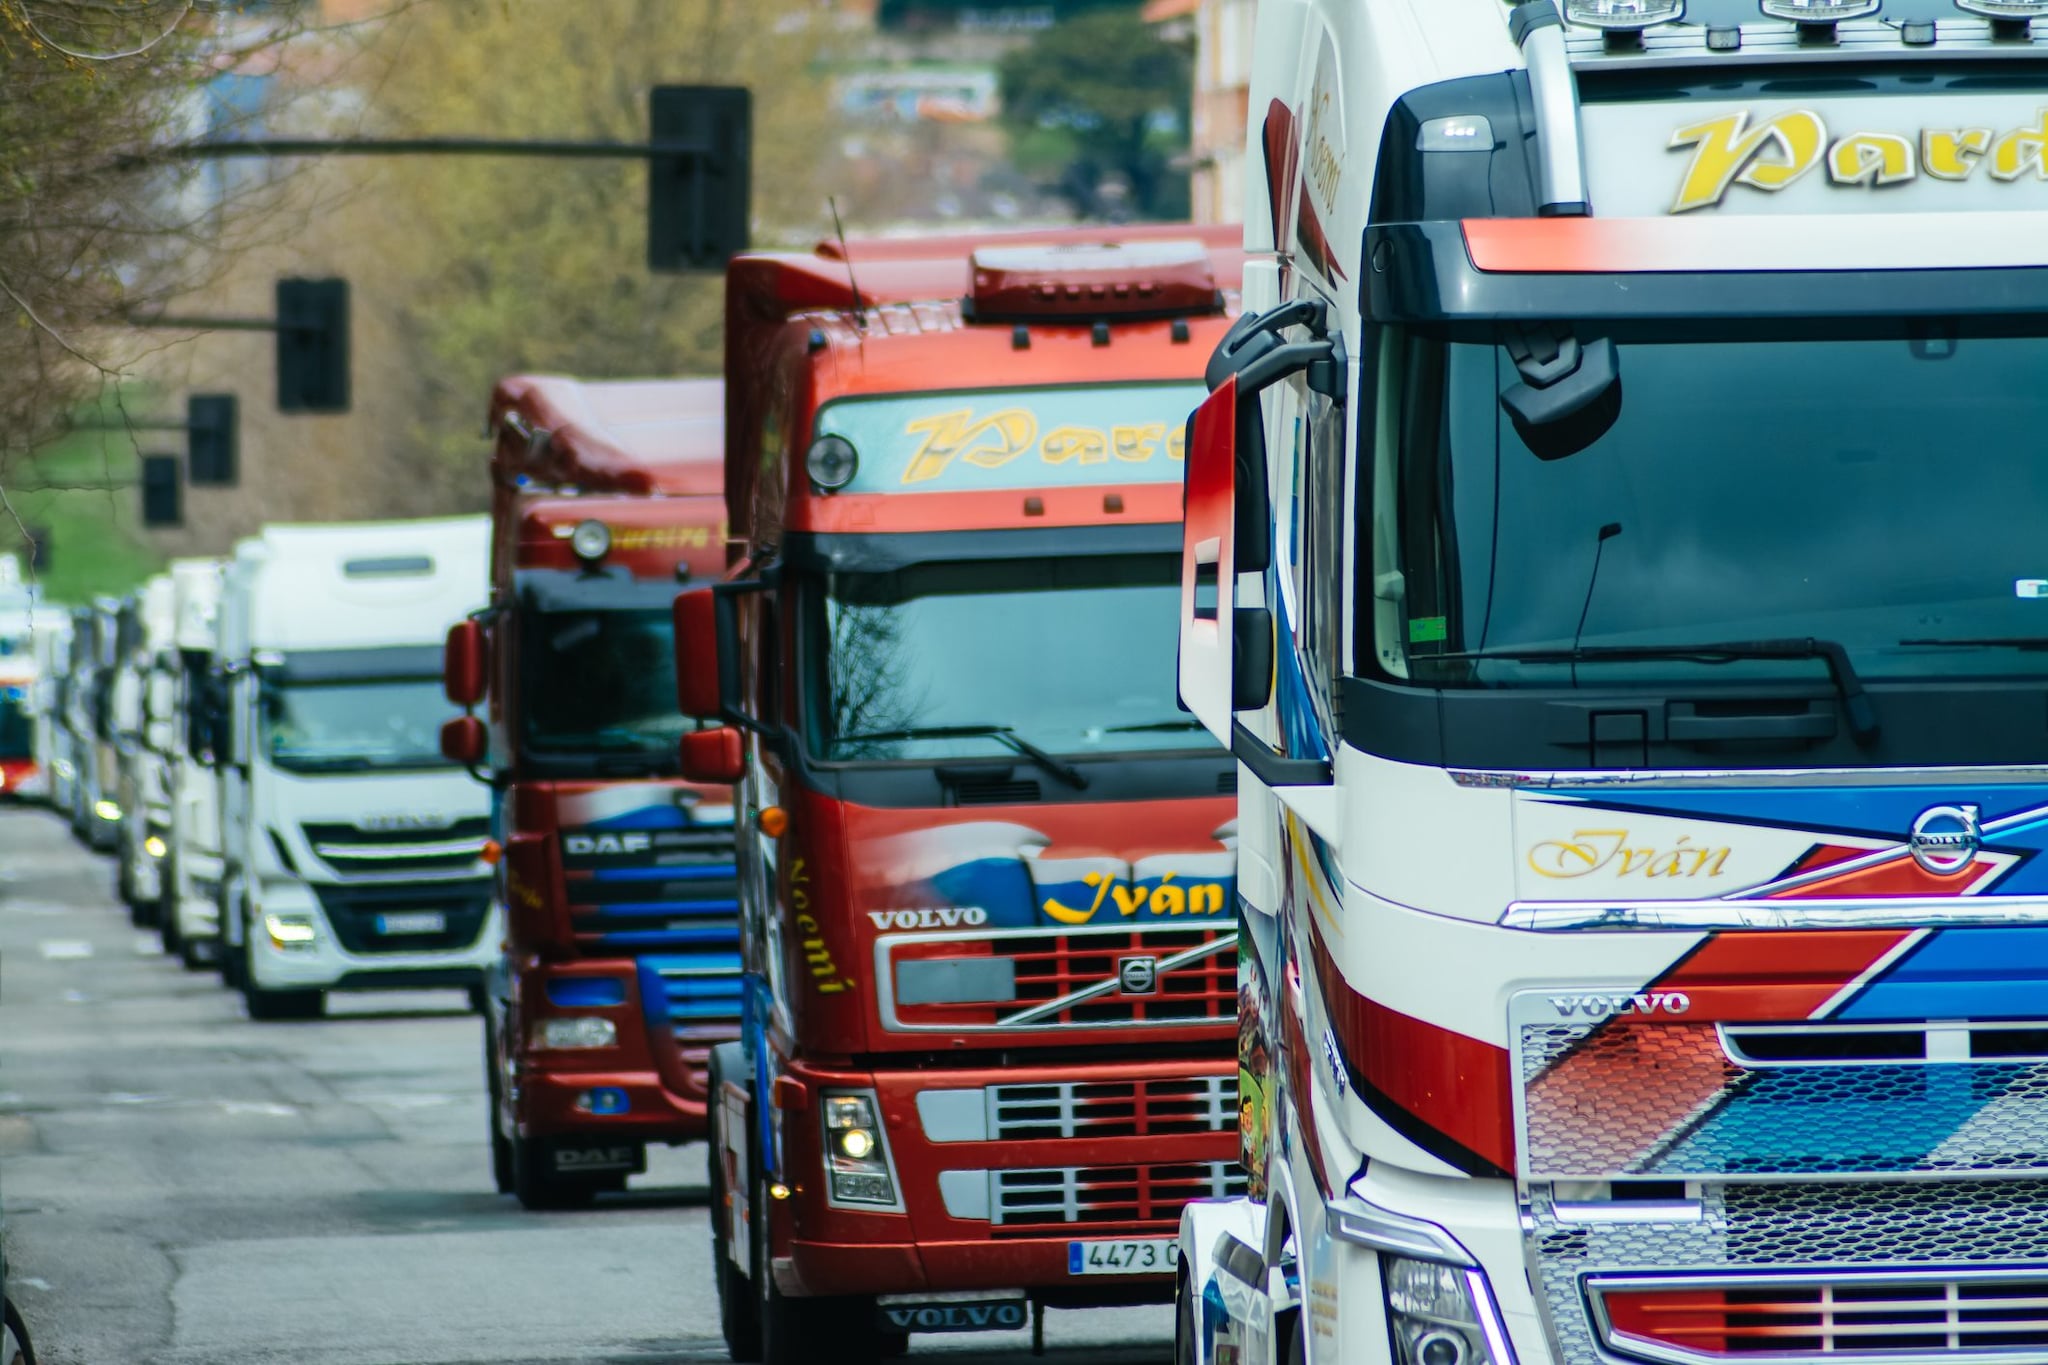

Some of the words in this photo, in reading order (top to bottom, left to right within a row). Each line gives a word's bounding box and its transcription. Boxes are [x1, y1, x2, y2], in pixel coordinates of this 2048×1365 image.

[565, 833, 649, 854] DAF
[1528, 829, 1732, 878] Iván
[1042, 871, 1225, 924] Iván
[868, 907, 987, 930] VOLVO
[1548, 992, 1690, 1017] VOLVO
[555, 1146, 633, 1165] DAF
[1089, 1244, 1155, 1267] 4473
[886, 1305, 1021, 1327] VOLVO
